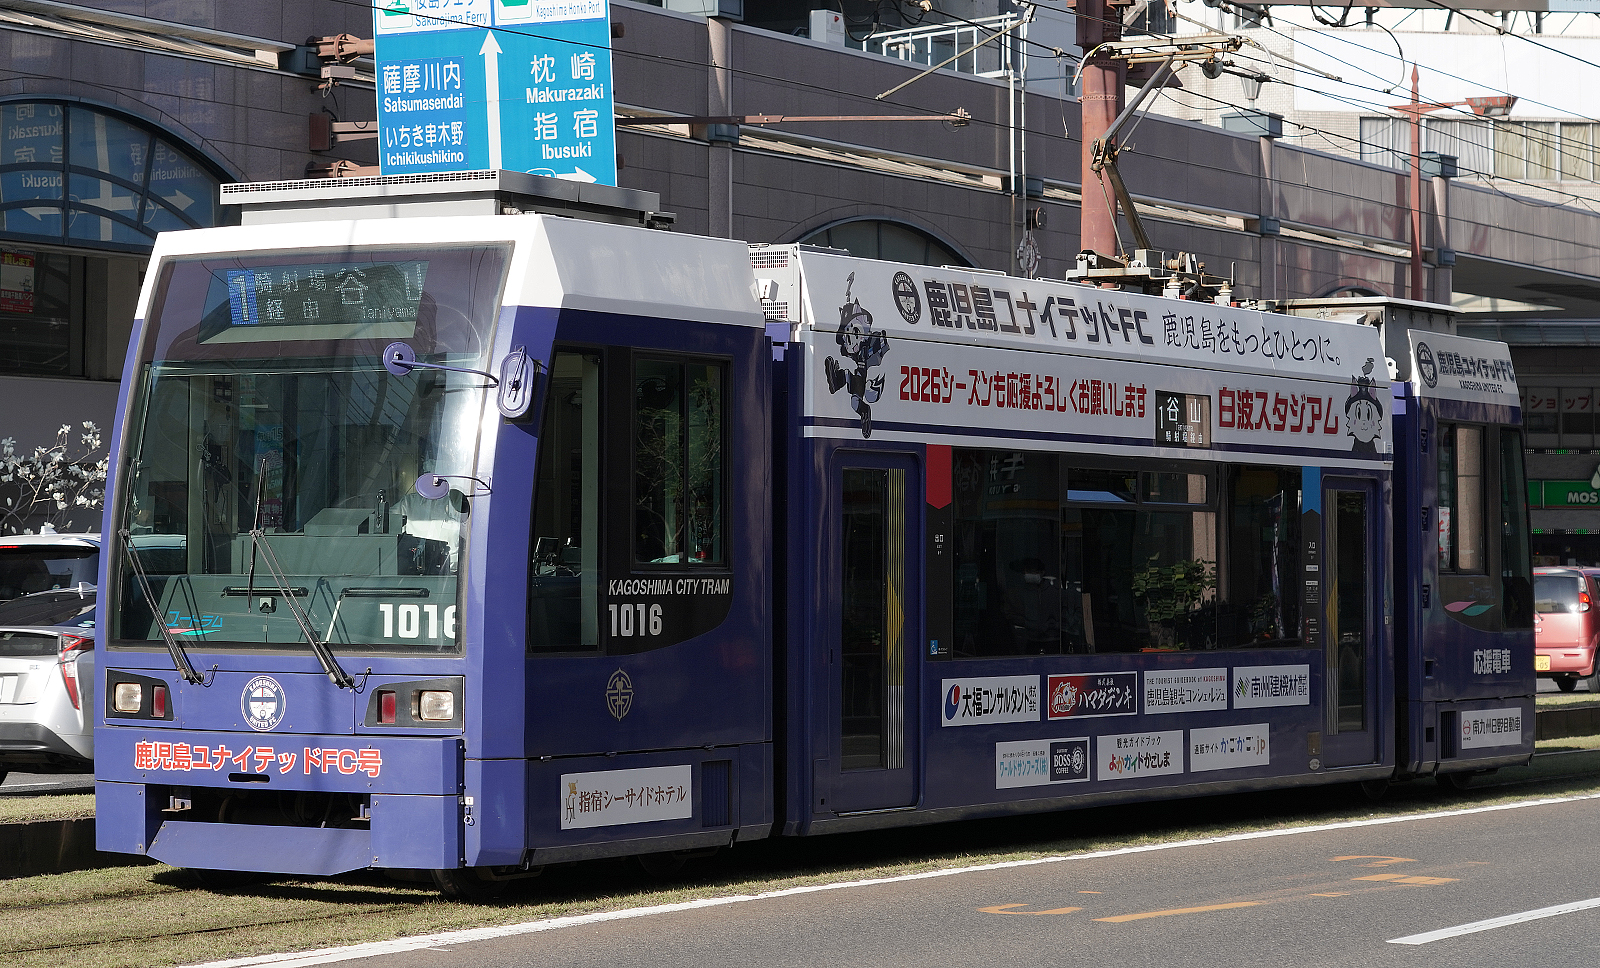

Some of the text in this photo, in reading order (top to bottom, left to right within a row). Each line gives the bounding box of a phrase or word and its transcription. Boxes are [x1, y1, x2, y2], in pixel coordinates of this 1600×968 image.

[415, 11, 488, 27] Sakurajima Ferry
[536, 4, 567, 19] Kagoshima
[588, 1, 600, 13] Port
[383, 60, 462, 94] 薩摩川内
[530, 52, 596, 84] 枕崎
[384, 93, 463, 113] Satsumasendai
[526, 84, 604, 104] Makurazaki
[386, 121, 463, 148] いちき串木野
[533, 107, 599, 141] 指宿
[387, 152, 464, 166] Ichikikushikino
[542, 142, 592, 160] Ibusuki
[359, 305, 417, 320] Taniyama
[923, 278, 1154, 346] 鹿児島ユナイテッドFC
[1162, 309, 1341, 366] 鹿児島をもっとひとつに。
[899, 365, 1148, 418] 2026シーズンも応援よろしくお願いします
[1159, 405, 1164, 429] 1
[1166, 396, 1201, 423] 谷山
[1218, 387, 1339, 434] 白波スタジアム
[1567, 491, 1598, 503] MOS
[608, 578, 730, 596] KAGOSHIMA CITY TRAM
[166, 611, 223, 628] ユートラム
[379, 603, 457, 639] 1016
[608, 603, 663, 637] 1016
[1473, 648, 1512, 675] 応援電車
[962, 685, 1029, 717] 大福コンサルタント
[1078, 685, 1133, 710] ハマダデンキ
[1147, 686, 1226, 707] 鹿児島観光コンシェルジュ
[1116, 735, 1161, 749] 観光ガイドブック
[134, 742, 383, 778] 鹿児島ユナイテッドFC号
[1053, 754, 1071, 768] BOSS
[1109, 750, 1171, 774] よかガイドかごしま
[578, 785, 687, 814] 指宿シーサイドホテル
